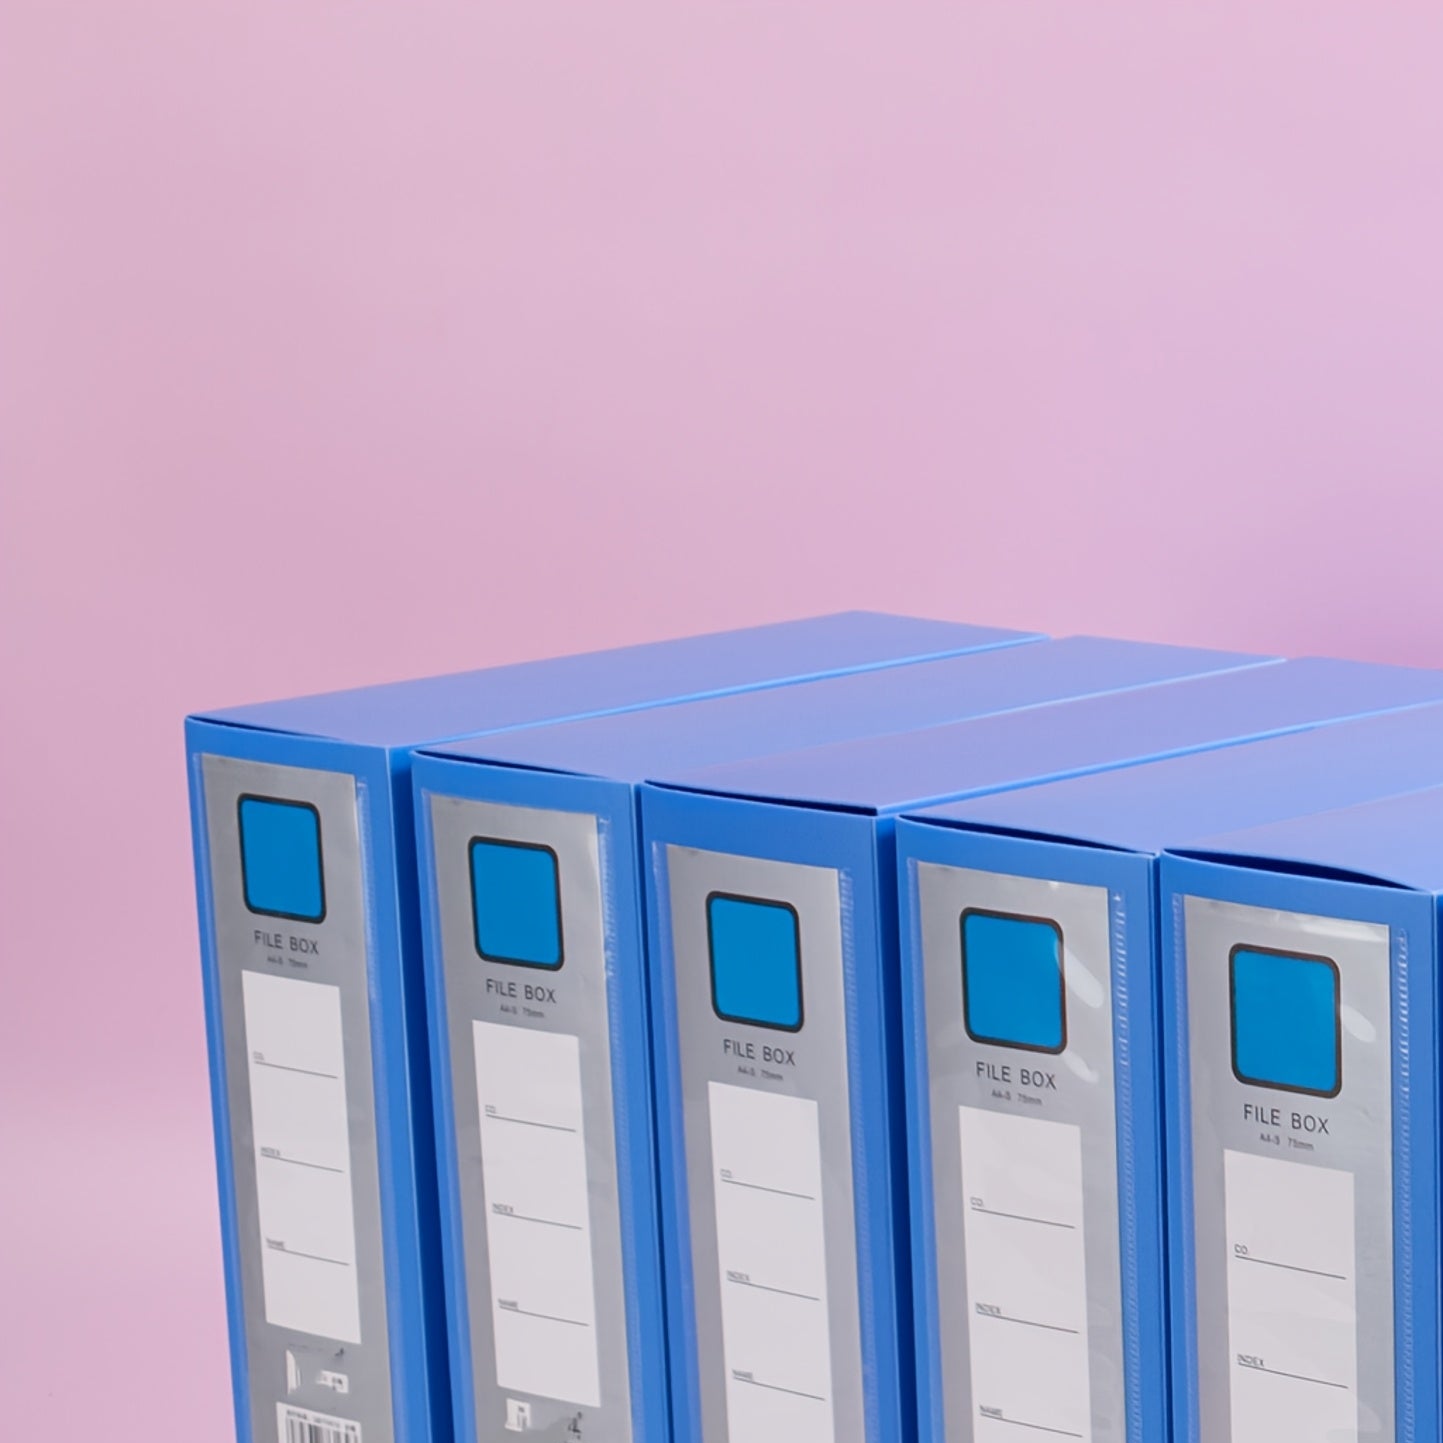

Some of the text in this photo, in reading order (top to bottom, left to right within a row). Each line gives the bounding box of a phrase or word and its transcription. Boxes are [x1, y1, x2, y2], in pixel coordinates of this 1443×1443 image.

[253, 930, 319, 955] FILE BOX
[486, 978, 557, 1004] FILE BOX
[723, 1039, 796, 1066] FILE BOX
[976, 1061, 1057, 1090] FILE BOX
[1243, 1103, 1330, 1135] FILE BOX
